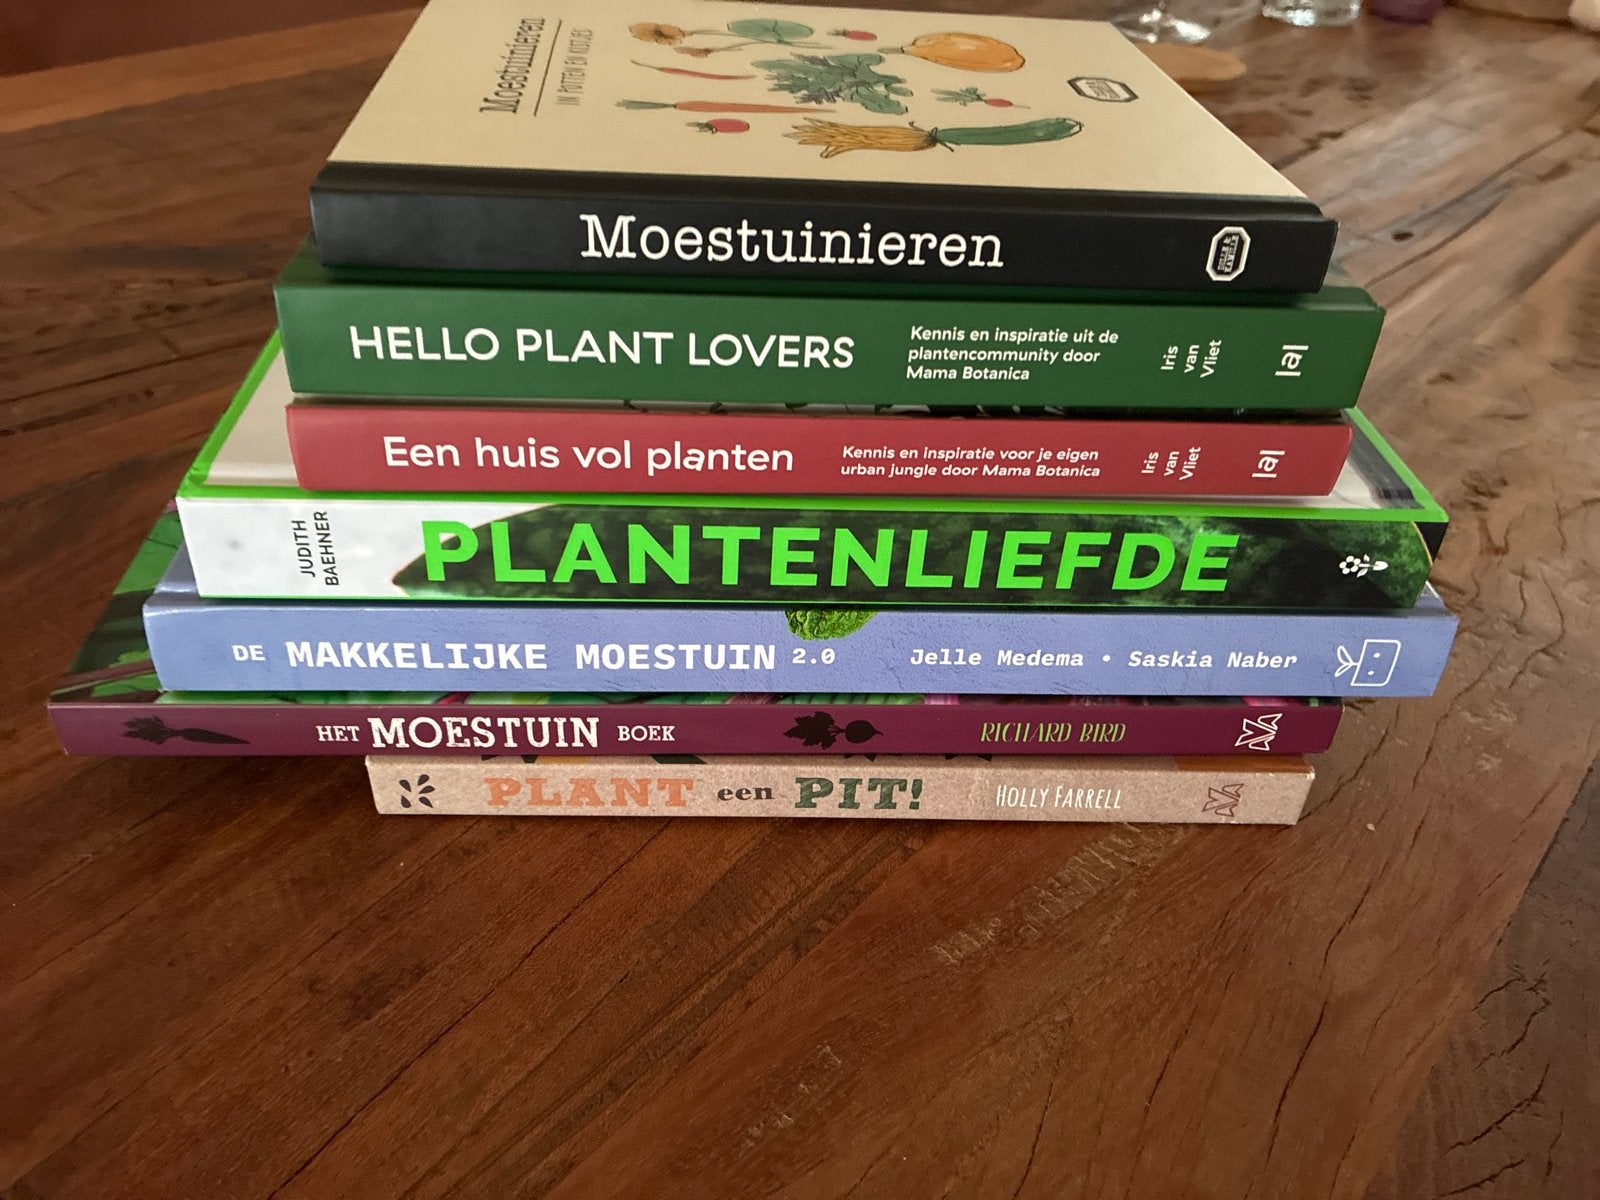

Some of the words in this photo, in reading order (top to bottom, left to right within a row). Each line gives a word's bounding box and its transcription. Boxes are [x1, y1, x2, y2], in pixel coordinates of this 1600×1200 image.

[479, 17, 546, 114] Moestuinieren
[557, 67, 585, 95] POTTEN
[579, 214, 1004, 268] Moestuinieren
[349, 325, 500, 361] HELLO
[516, 328, 674, 365] PLANT
[688, 332, 855, 369] LOVERS
[910, 325, 965, 342] Kennis
[969, 329, 990, 342] en
[994, 326, 1069, 346] inspiratie
[1072, 329, 1095, 344] uit
[1099, 329, 1119, 344] de
[907, 346, 1059, 364] plantencommunity
[1062, 348, 1101, 363] door
[1161, 345, 1179, 371] Iris
[1184, 344, 1200, 373] van
[1200, 339, 1222, 378] Vliet
[906, 366, 957, 380] Mama
[962, 366, 1030, 381] Botanica
[383, 436, 460, 467] Een
[474, 437, 560, 468] huis
[572, 440, 631, 469] vol
[647, 440, 794, 477] planten
[842, 445, 895, 459] Kennis
[899, 448, 919, 459] en
[922, 447, 995, 463] inspiratie
[999, 449, 1035, 461] voor
[1036, 447, 1053, 463] je
[1056, 448, 1099, 464] eigen
[1141, 452, 1159, 474] Iris
[1163, 450, 1180, 477] van
[1180, 446, 1201, 480] Vliet
[840, 463, 886, 476] urban
[887, 463, 937, 479] jungle
[941, 463, 977, 476] door
[981, 464, 1032, 477] Mama
[1035, 464, 1101, 478] Botanica
[291, 519, 316, 577] JUDITH
[314, 511, 339, 586] BAEHNER
[421, 520, 1241, 592] PLANTENLIEFDE
[232, 644, 265, 661] DE
[285, 641, 547, 670] MAKKELIJKE
[575, 643, 776, 670] MOESTUIN
[791, 647, 836, 666] 2.0
[909, 647, 982, 666] Jelle
[996, 648, 1084, 668] Medema
[1127, 649, 1213, 668] Saskia
[1226, 650, 1298, 669] Naber
[316, 725, 360, 743] HET
[366, 716, 600, 749] MOESTUIN
[617, 725, 675, 743] BOEK
[980, 722, 1073, 743] RICHARD
[1078, 722, 1127, 744] BIRD
[483, 777, 694, 807] PLANT
[716, 785, 775, 802] een
[794, 776, 923, 810] PIT!
[996, 784, 1050, 808] HOLLY
[1055, 784, 1122, 810] FARRELL
